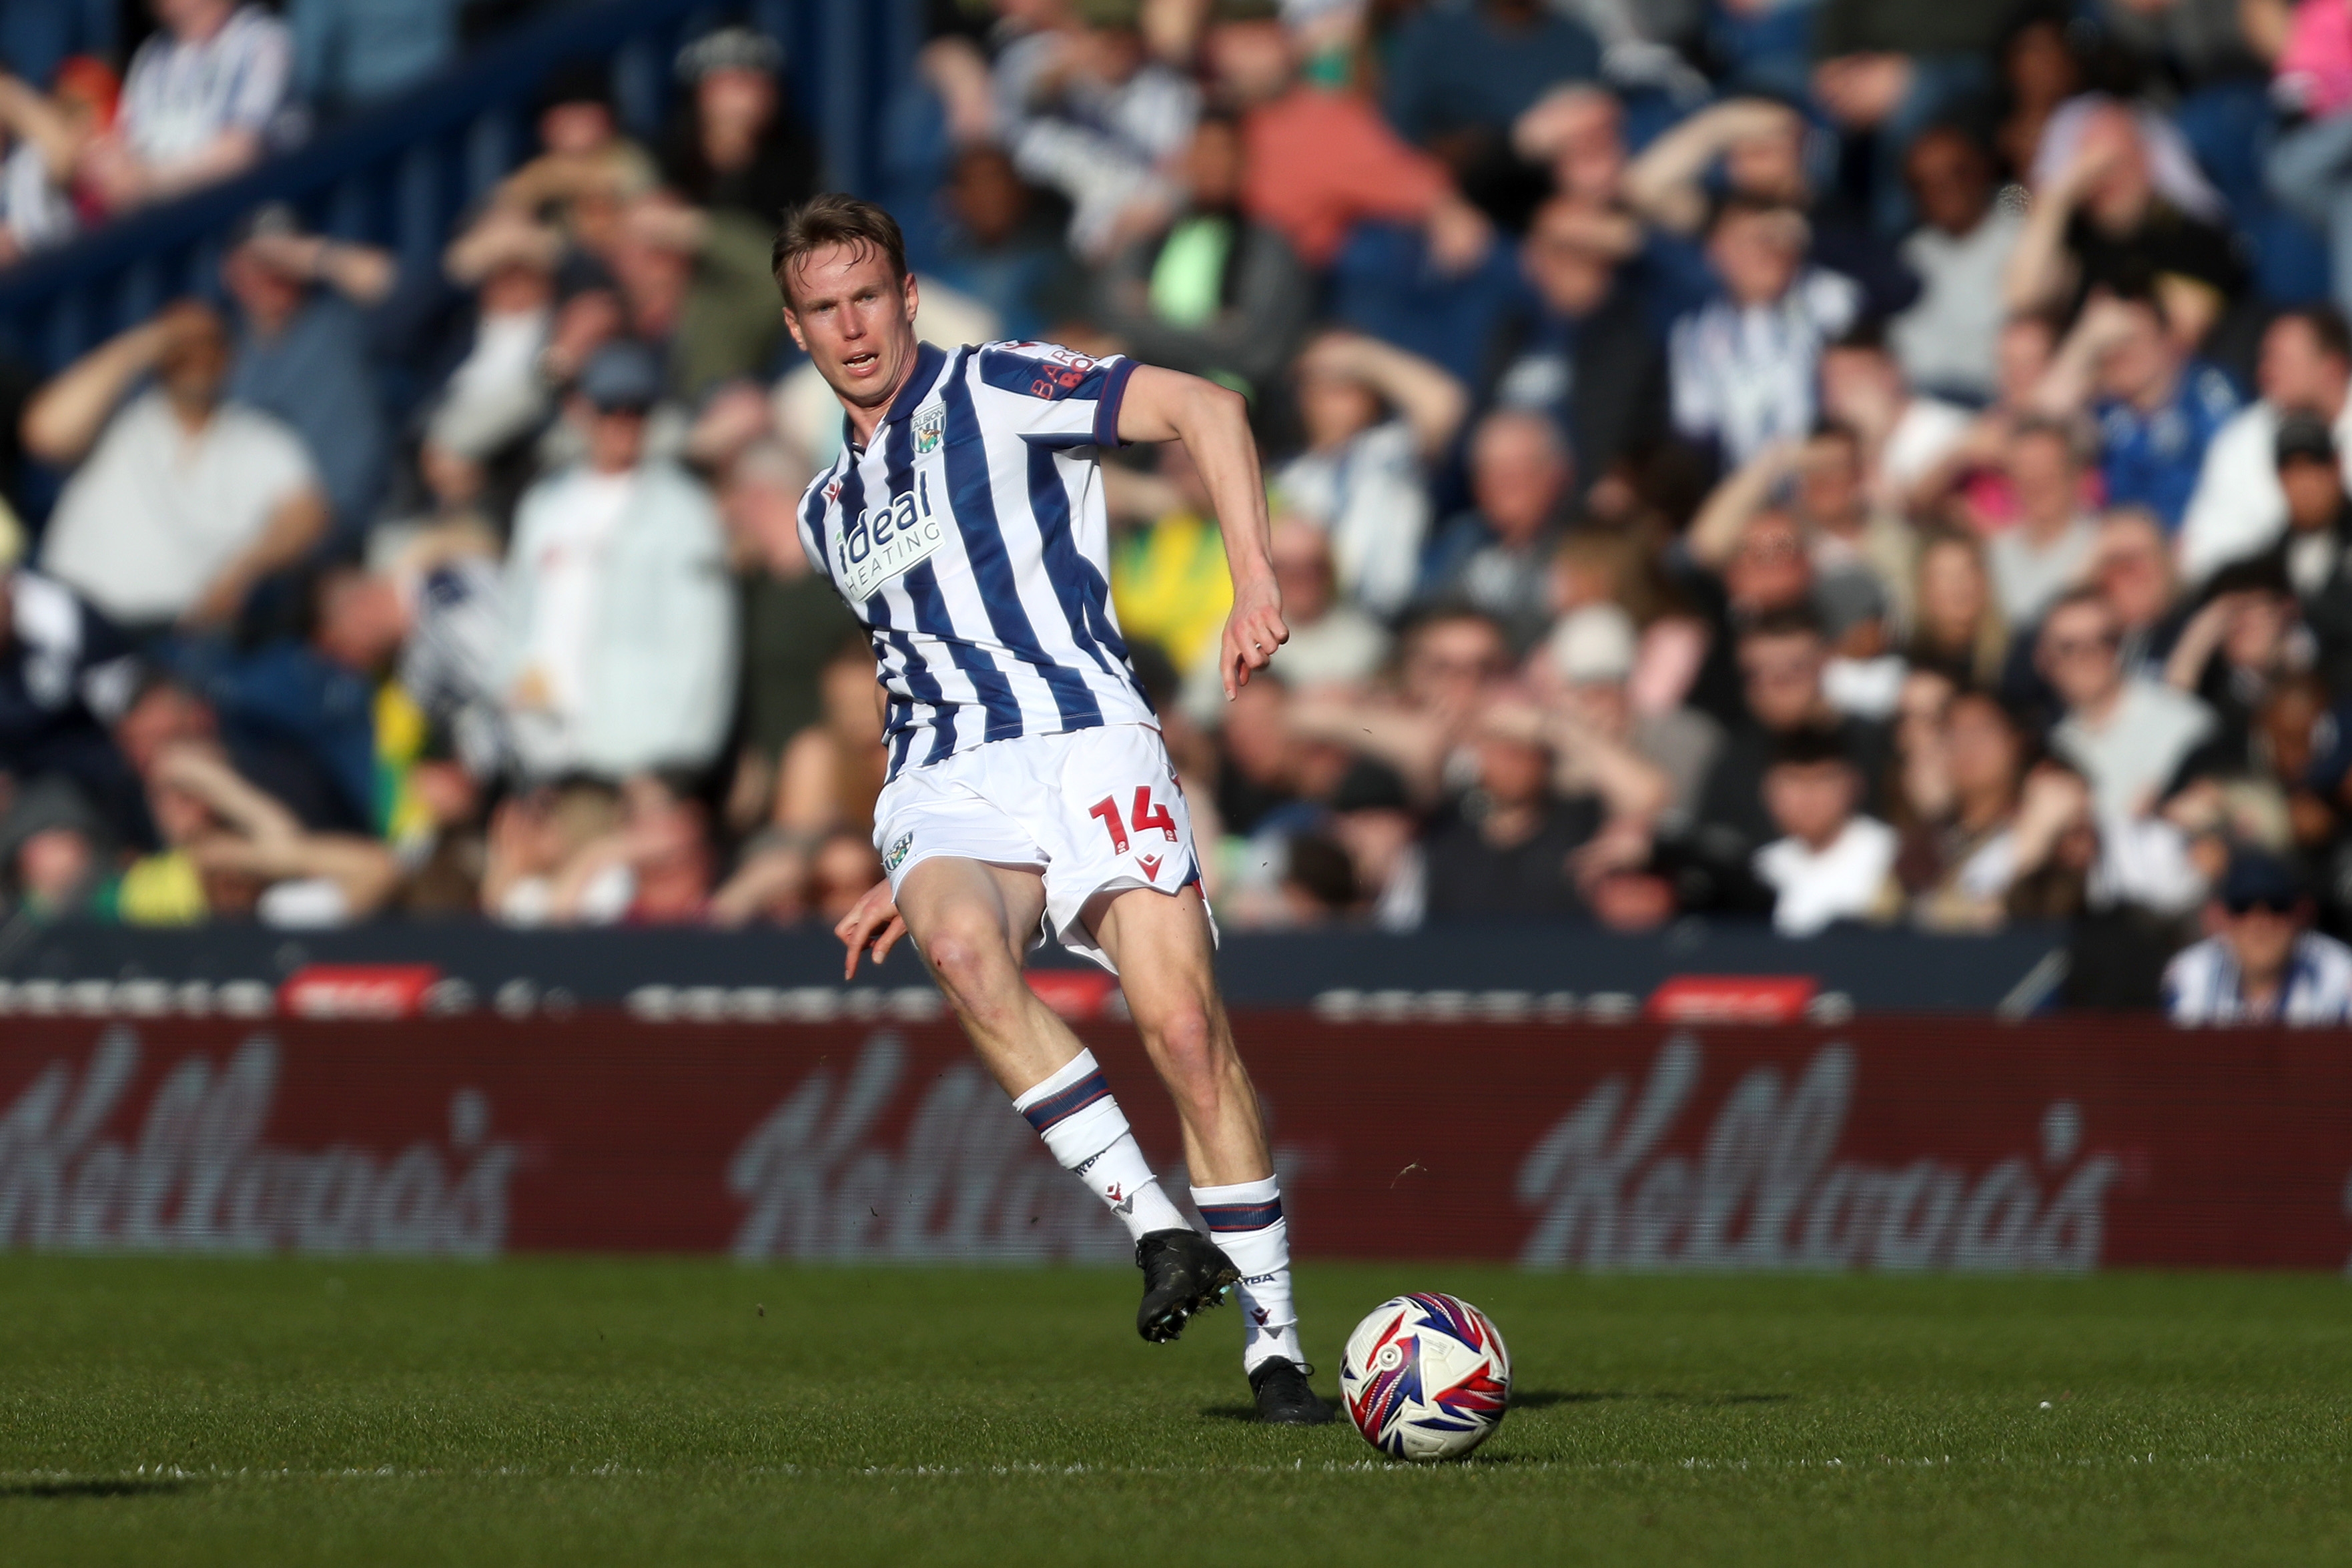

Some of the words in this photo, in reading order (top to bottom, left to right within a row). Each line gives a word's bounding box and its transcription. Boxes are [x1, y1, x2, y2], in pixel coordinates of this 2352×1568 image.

[1030, 349, 1082, 400] BAR
[1058, 354, 1096, 388] BO
[835, 470, 932, 576] ideal
[831, 522, 940, 596] HEATING
[1088, 785, 1177, 856] 14
